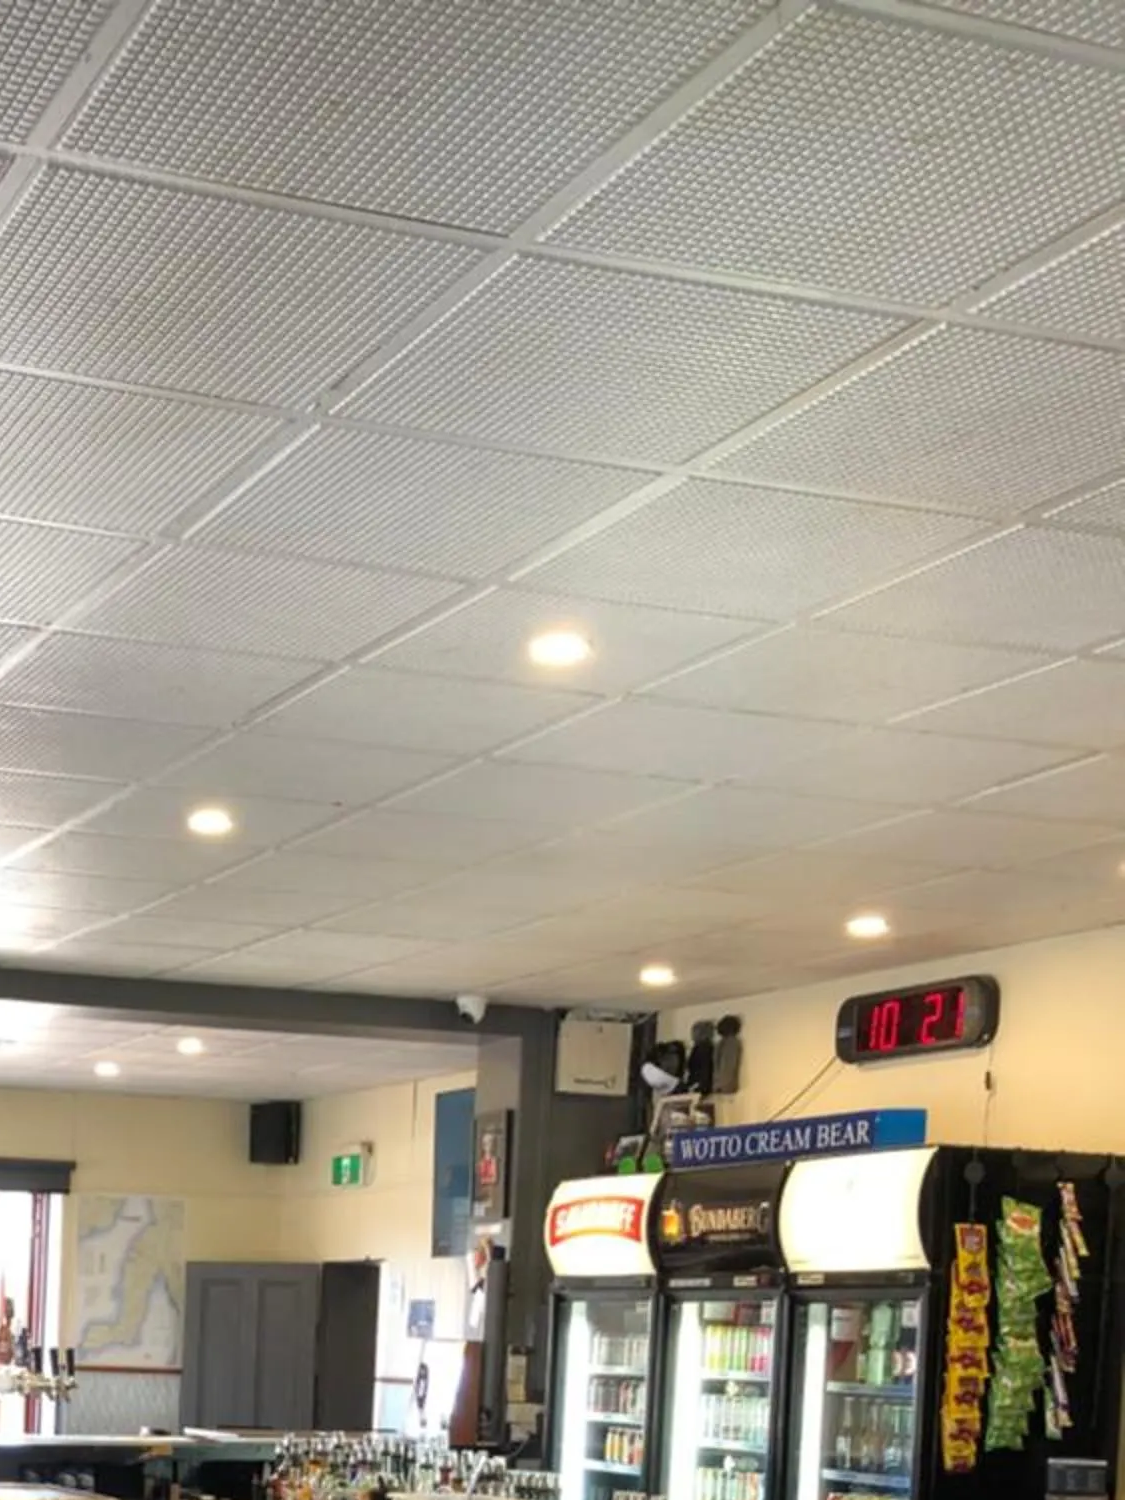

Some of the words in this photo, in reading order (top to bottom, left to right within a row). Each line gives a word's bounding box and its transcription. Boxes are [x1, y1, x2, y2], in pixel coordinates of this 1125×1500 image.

[869, 998, 900, 1051] 10
[920, 991, 965, 1046] 21
[681, 1134, 742, 1161] WOTTO
[745, 1126, 811, 1155] CREAM
[816, 1119, 870, 1148] BEAR
